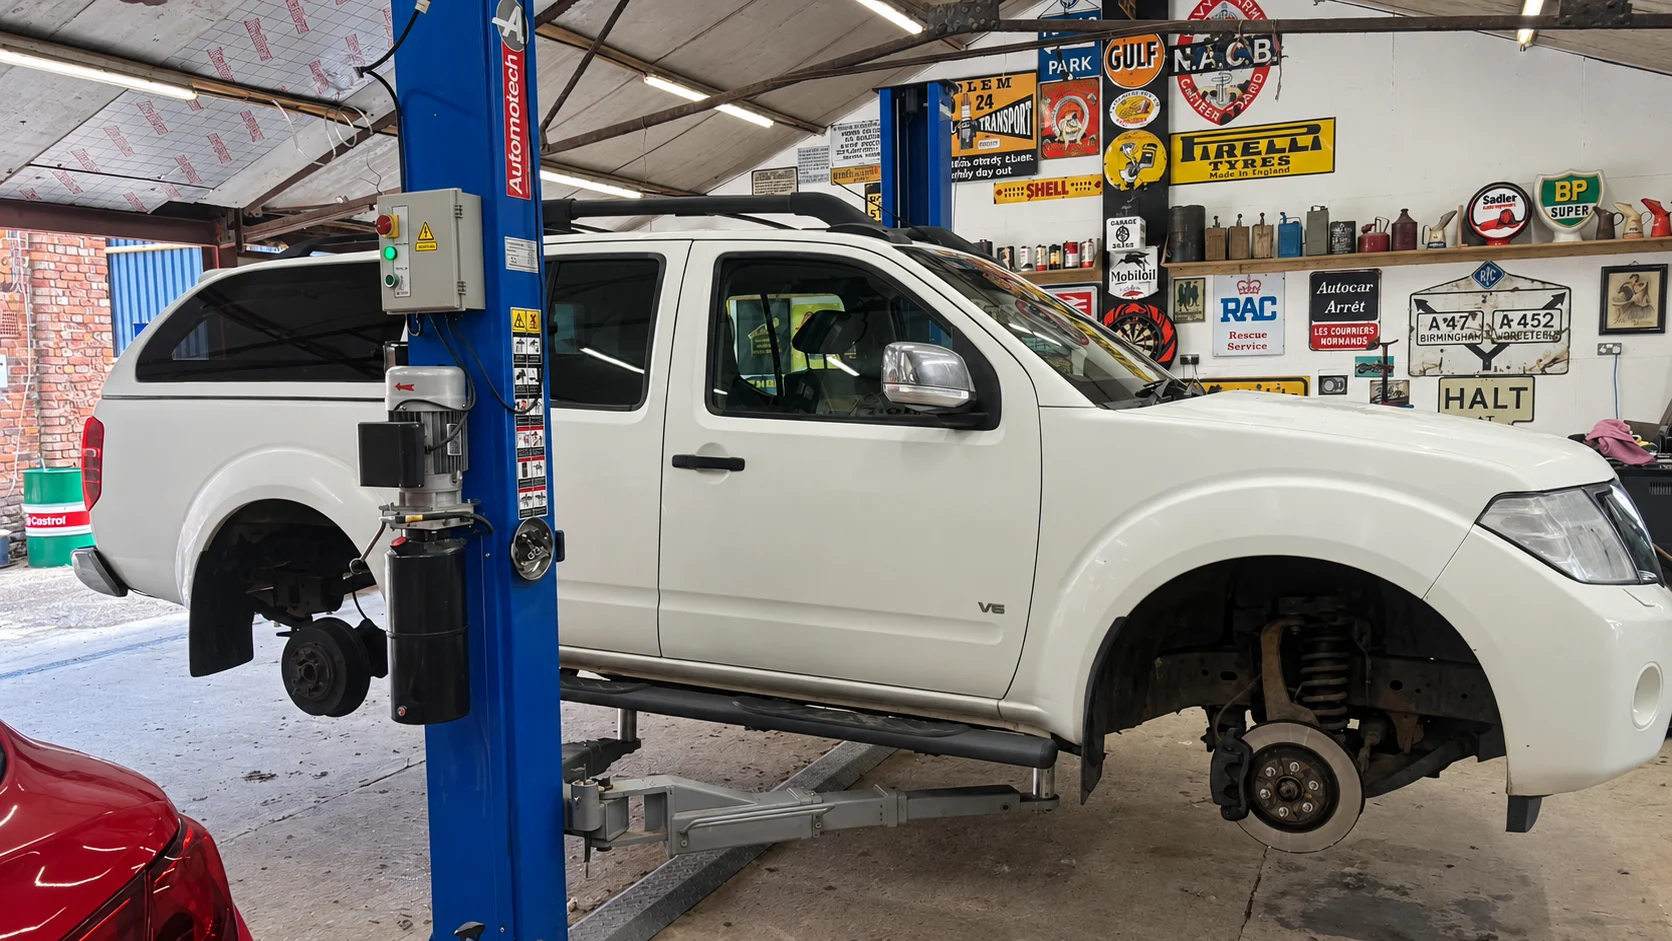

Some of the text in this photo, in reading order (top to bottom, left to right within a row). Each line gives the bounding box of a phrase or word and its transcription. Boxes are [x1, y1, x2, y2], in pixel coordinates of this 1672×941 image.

[1107, 41, 1159, 72] GULF
[1048, 55, 1092, 75] PARK
[958, 77, 1013, 94] LEM
[976, 93, 994, 111] 24
[504, 53, 524, 195] Automotech
[979, 100, 1032, 135] TRANSPORT
[1180, 123, 1322, 163] PIRELLI
[1208, 155, 1291, 171] TYRES
[976, 168, 994, 180] day
[995, 166, 1012, 176] out
[1209, 171, 1235, 179] Made
[1252, 166, 1291, 176] England
[1026, 180, 1069, 201] SHELL
[1555, 179, 1588, 202] BP
[1483, 194, 1517, 205] Sadler
[1551, 205, 1590, 218] SUPER
[1111, 269, 1156, 282] Mobiloil
[1316, 281, 1374, 295] Autocar
[1220, 296, 1277, 322] RAC
[1324, 300, 1366, 314] Arrêt
[1517, 312, 1555, 329] 452
[1229, 331, 1268, 340] Rescue
[1314, 326, 1375, 336] LES COURRIERS
[1227, 342, 1268, 351] Service
[1444, 387, 1529, 410] HALT
[31, 516, 66, 525] Castrol
[977, 601, 1005, 614] V6
